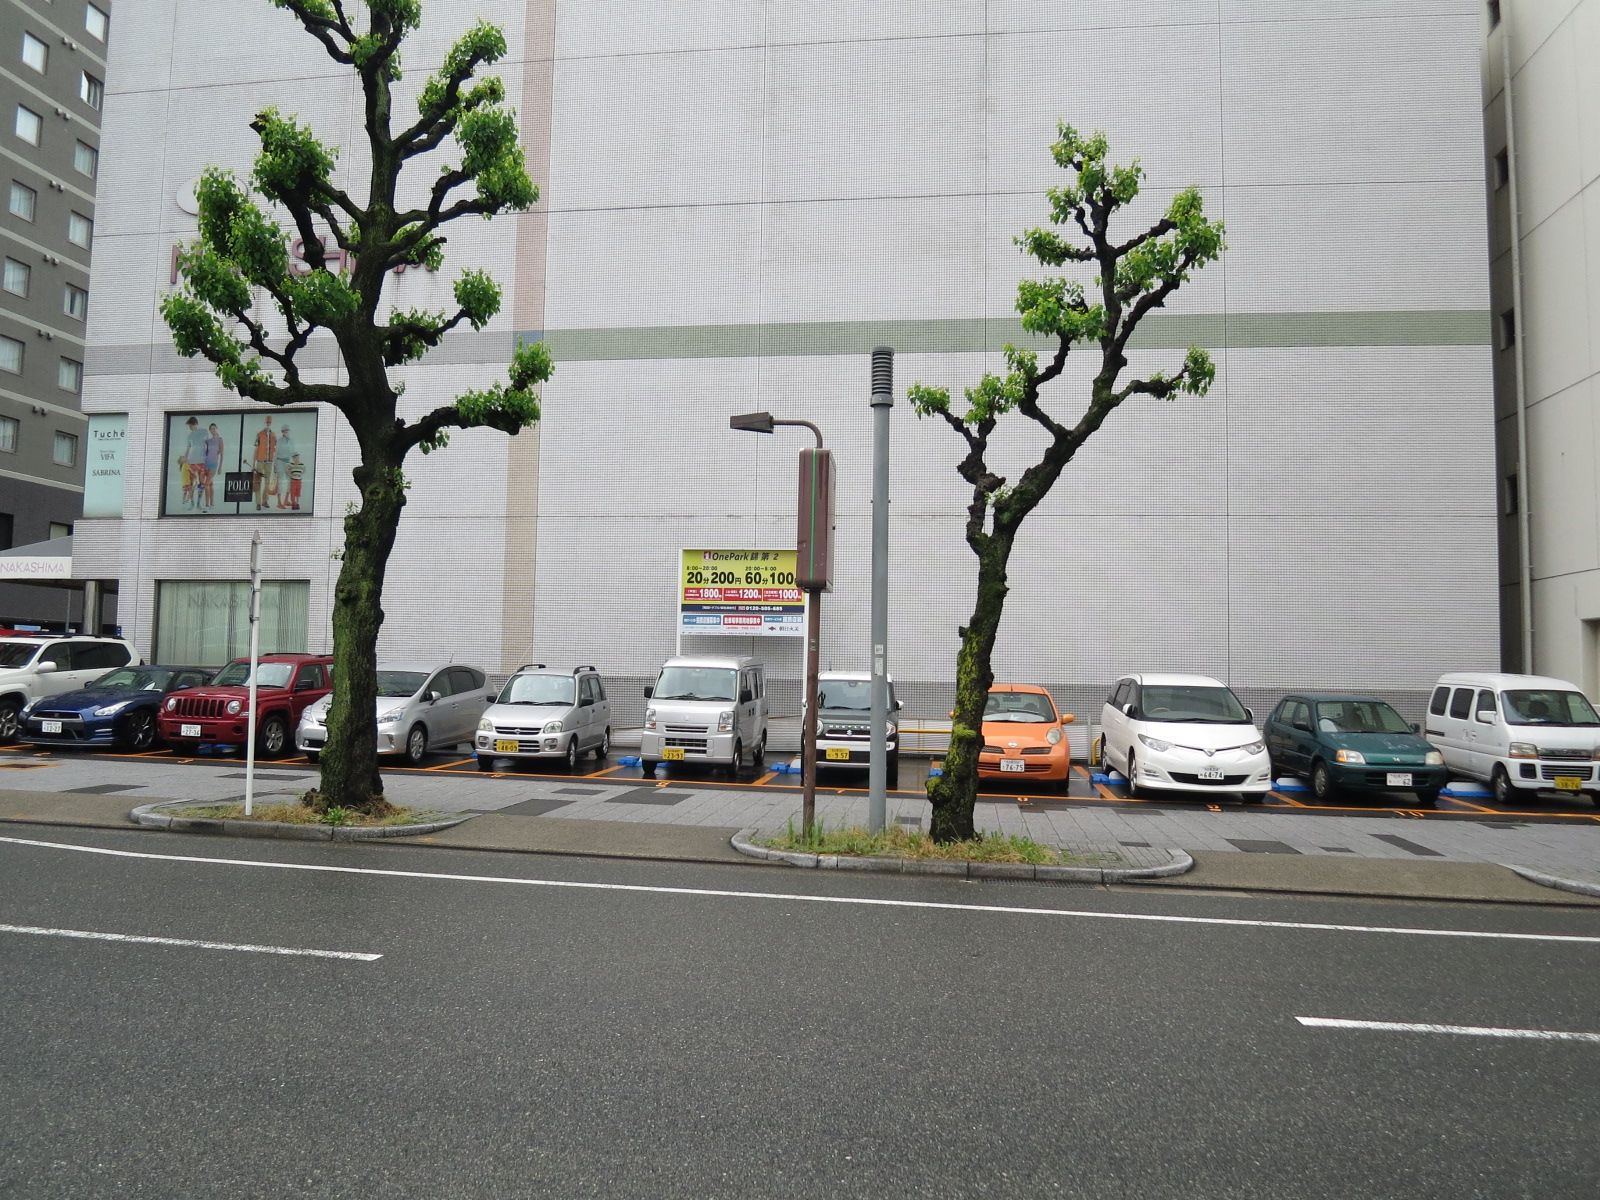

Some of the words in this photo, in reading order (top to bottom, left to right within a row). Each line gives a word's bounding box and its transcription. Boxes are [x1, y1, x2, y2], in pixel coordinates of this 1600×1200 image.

[92, 468, 121, 477] SABRINA
[227, 480, 250, 492] POLO
[712, 552, 748, 561] OnePark
[0, 561, 65, 573] NAKASHIMA
